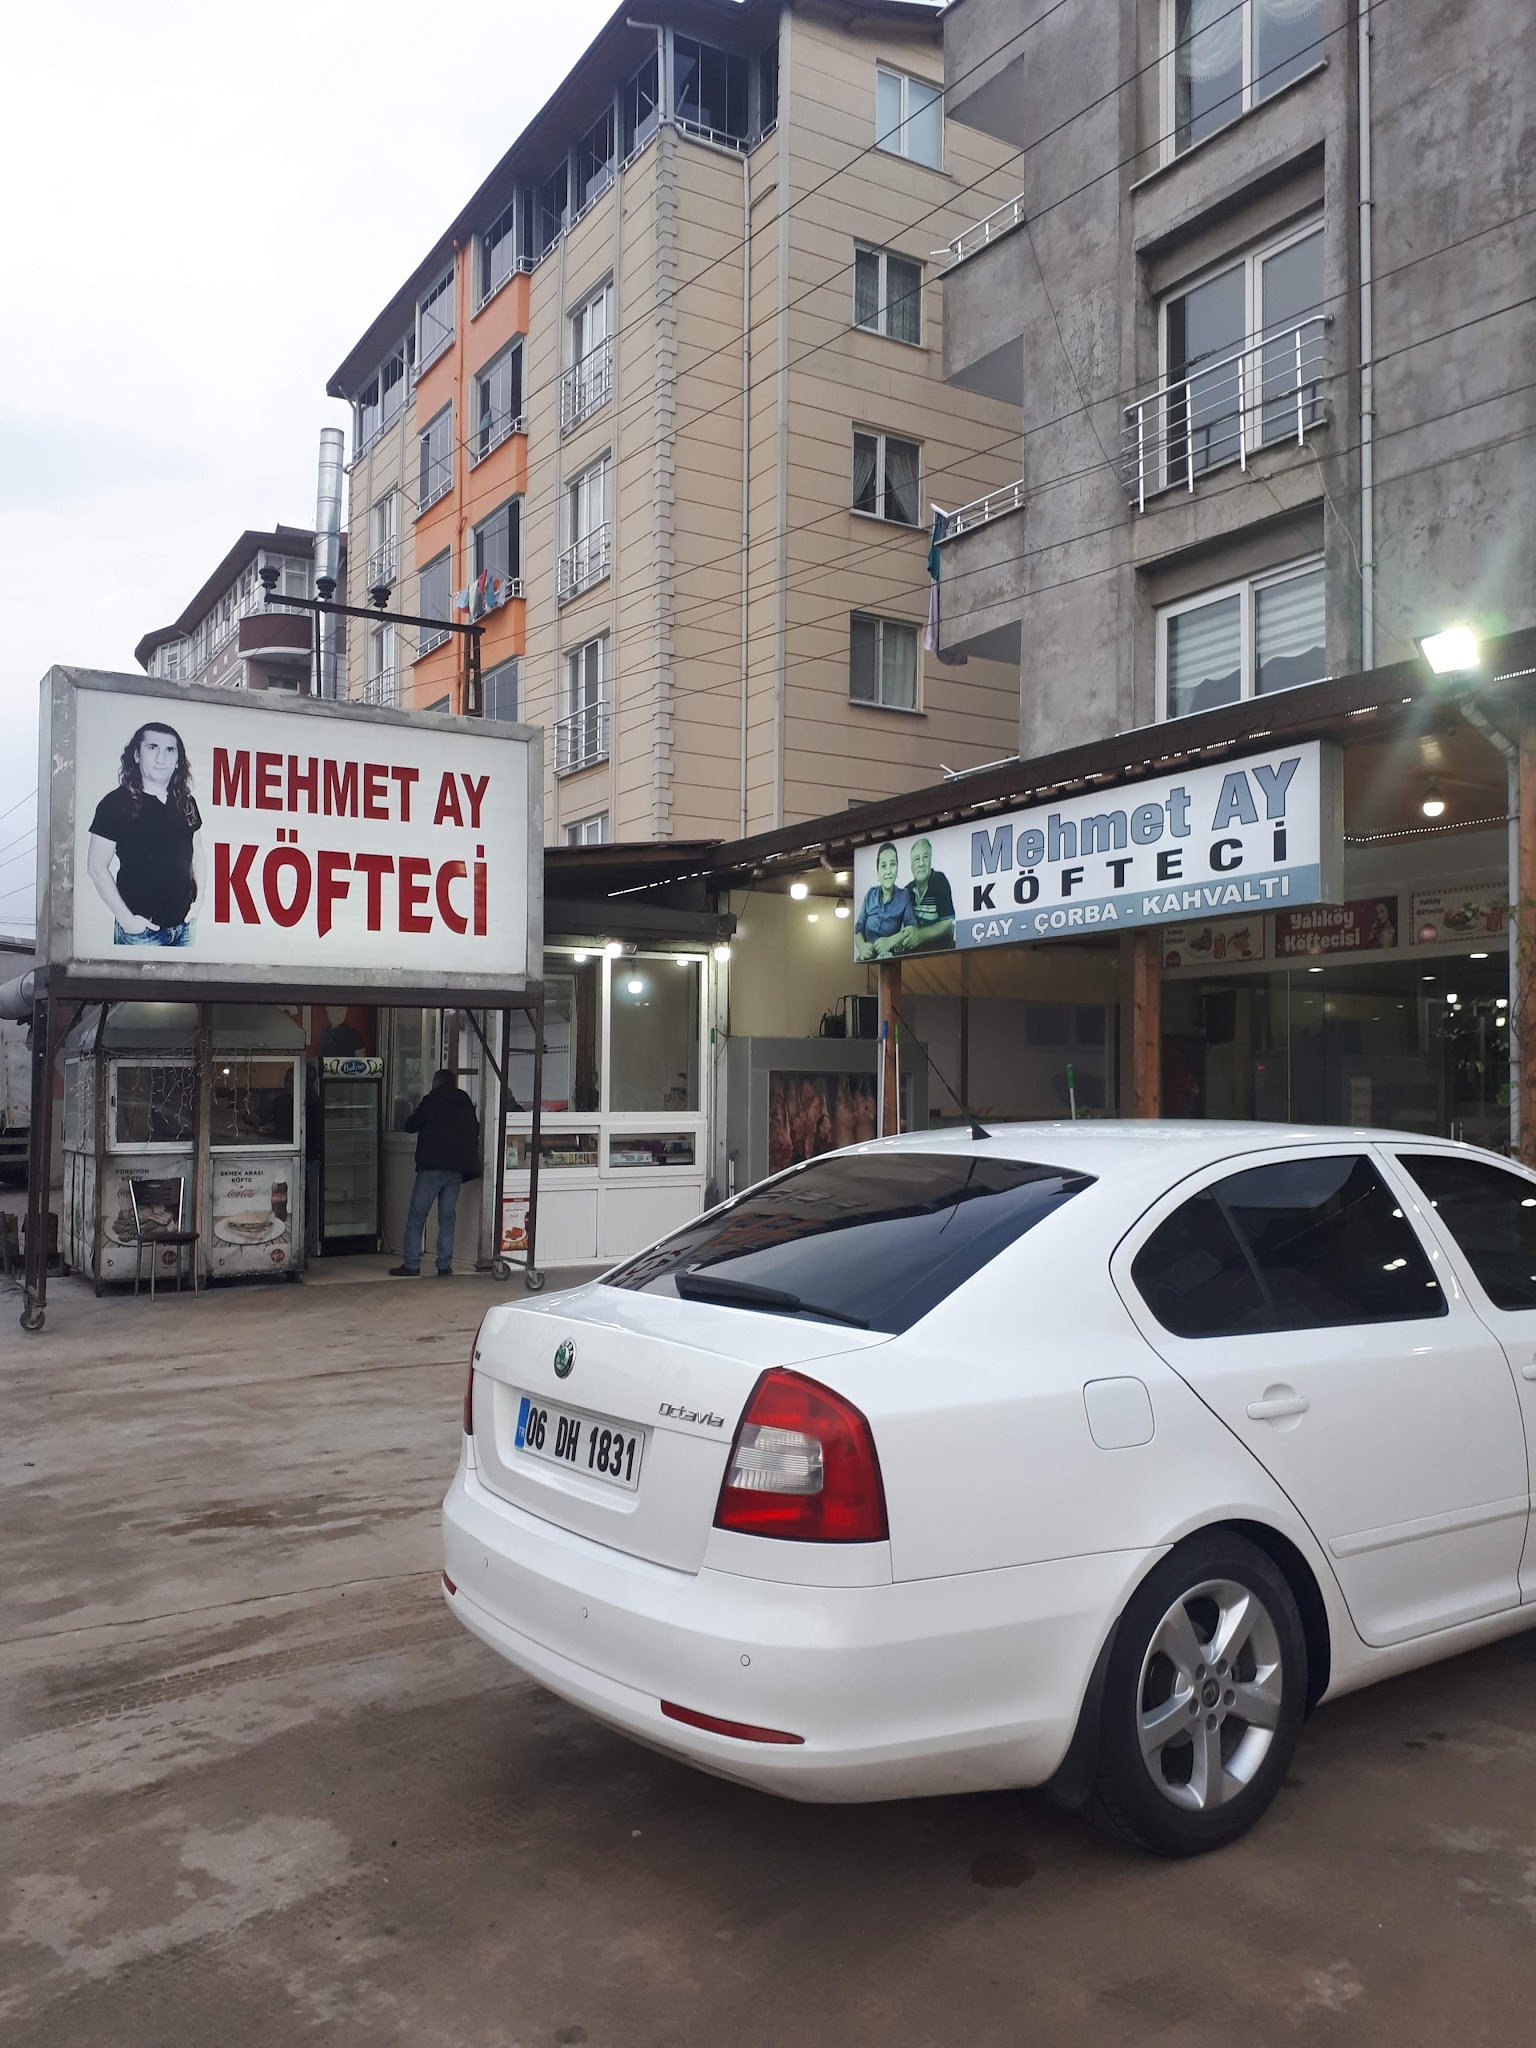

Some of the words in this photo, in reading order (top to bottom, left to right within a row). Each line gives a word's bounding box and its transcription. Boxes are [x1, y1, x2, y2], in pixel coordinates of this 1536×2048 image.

[212, 747, 419, 823] MEHMET
[433, 771, 490, 829] AY
[970, 786, 1191, 877] Mehmet
[1211, 757, 1301, 831] AY
[214, 827, 487, 939] KÖFTECİ
[972, 820, 1288, 912] KÖFTECİ
[971, 918, 1014, 944] ÇAY
[1034, 902, 1119, 935] ÇORBA
[1142, 874, 1290, 916] KAHVALTI
[1284, 927, 1361, 952] Köftecisi
[1290, 907, 1354, 930] Yalıköy
[231, 1176, 252, 1184] KÖFTE
[525, 1407, 548, 1450] 06
[554, 1415, 581, 1462] DH
[588, 1426, 636, 1481] 1831
[658, 1402, 725, 1428] Octavia
